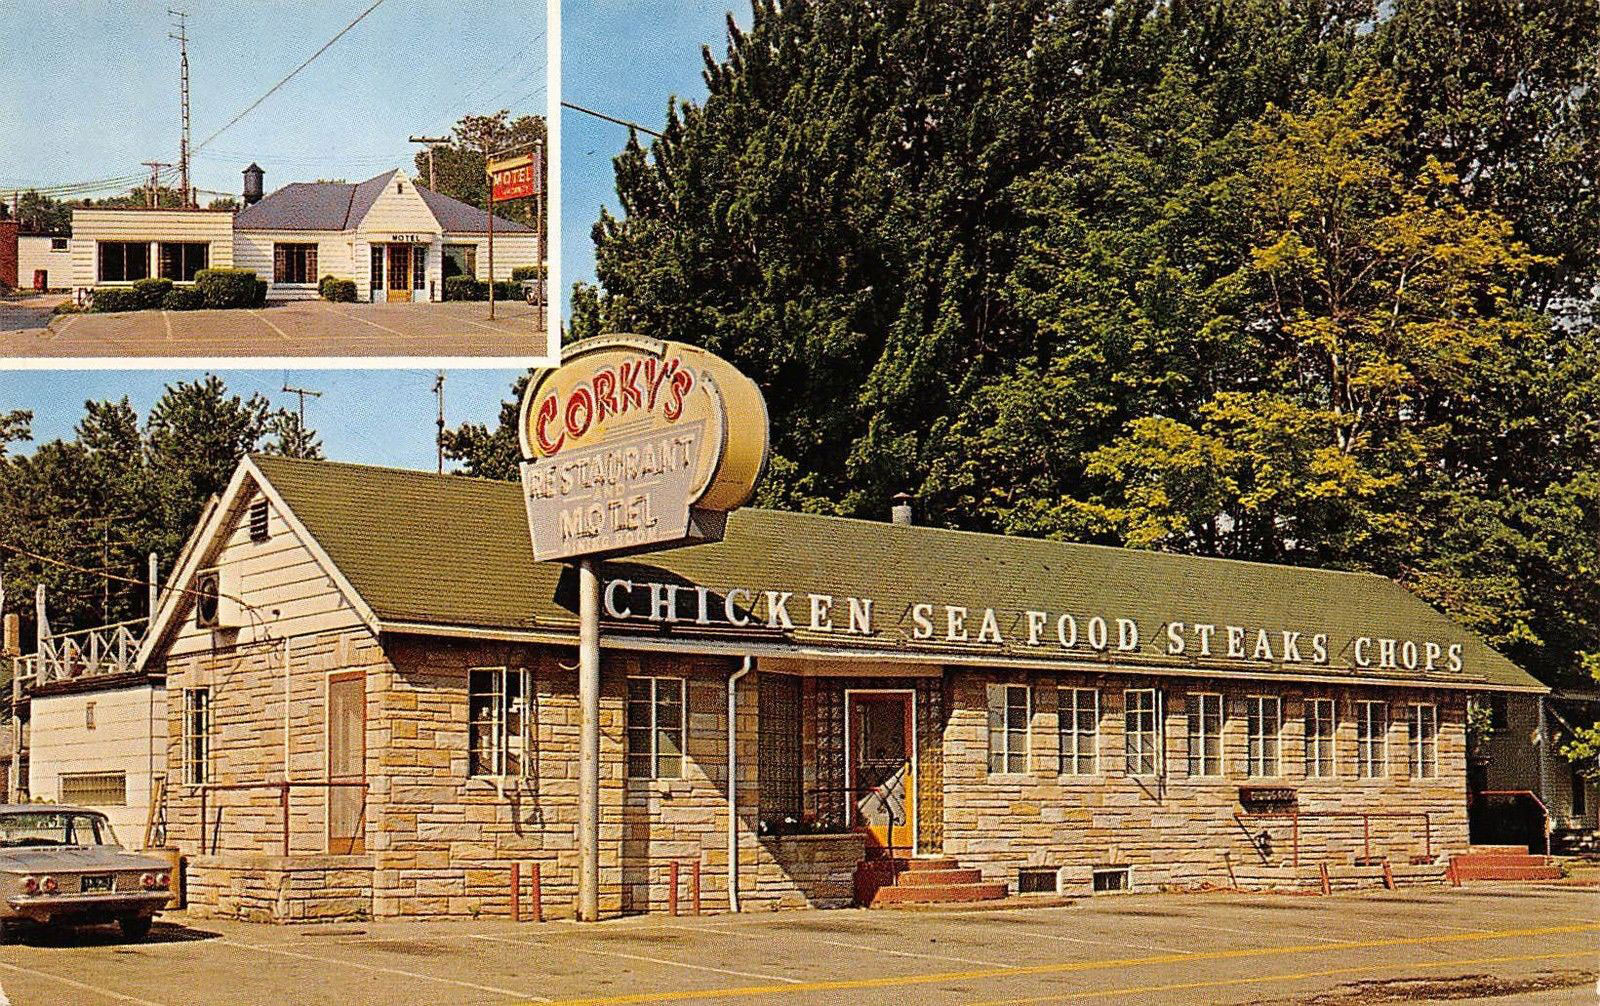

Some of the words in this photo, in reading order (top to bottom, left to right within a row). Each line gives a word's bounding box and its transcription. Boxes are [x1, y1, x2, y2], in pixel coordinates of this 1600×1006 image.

[493, 167, 530, 186] MOTEL
[535, 356, 694, 457] CORKY'S
[530, 437, 693, 501] RESTAURANT
[558, 493, 659, 544] MOTEL
[603, 579, 876, 636] CHICKEN
[912, 603, 1004, 644] SEA
[1025, 611, 1139, 652] FOOD
[1167, 621, 1329, 664] STEAKS
[1353, 637, 1463, 672] CHOPS
